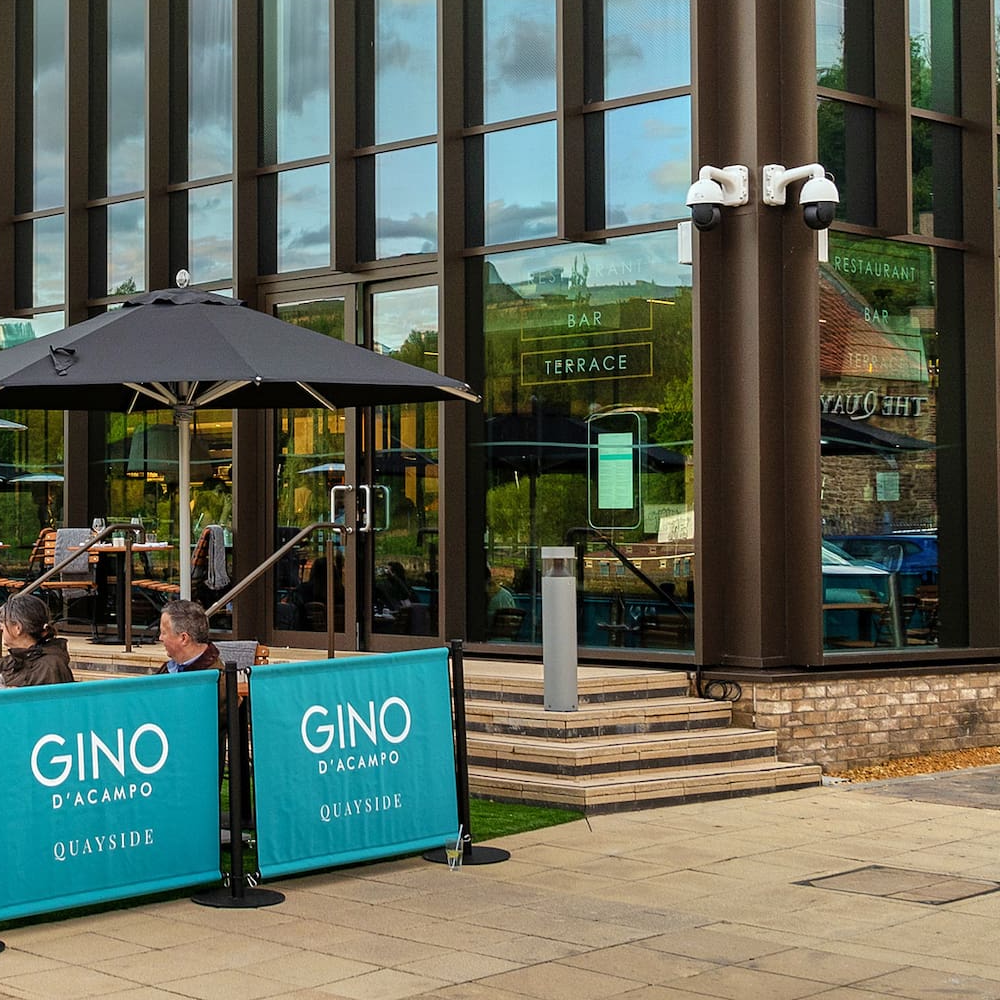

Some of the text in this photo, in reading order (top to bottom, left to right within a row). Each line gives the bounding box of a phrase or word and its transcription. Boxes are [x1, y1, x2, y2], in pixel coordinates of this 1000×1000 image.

[527, 258, 643, 287] RESRANT
[834, 256, 916, 281] RESTAURANT
[567, 311, 602, 328] BAR
[864, 307, 889, 324] BAR
[544, 354, 628, 376] TERRACE
[301, 696, 412, 754] GINO
[30, 722, 170, 787] GINO
[318, 750, 400, 775] D'ACAMPO
[52, 781, 153, 809] D'ACAMPO
[319, 792, 403, 822] QUAYSIDE
[53, 828, 155, 862] QUAYSIDE
